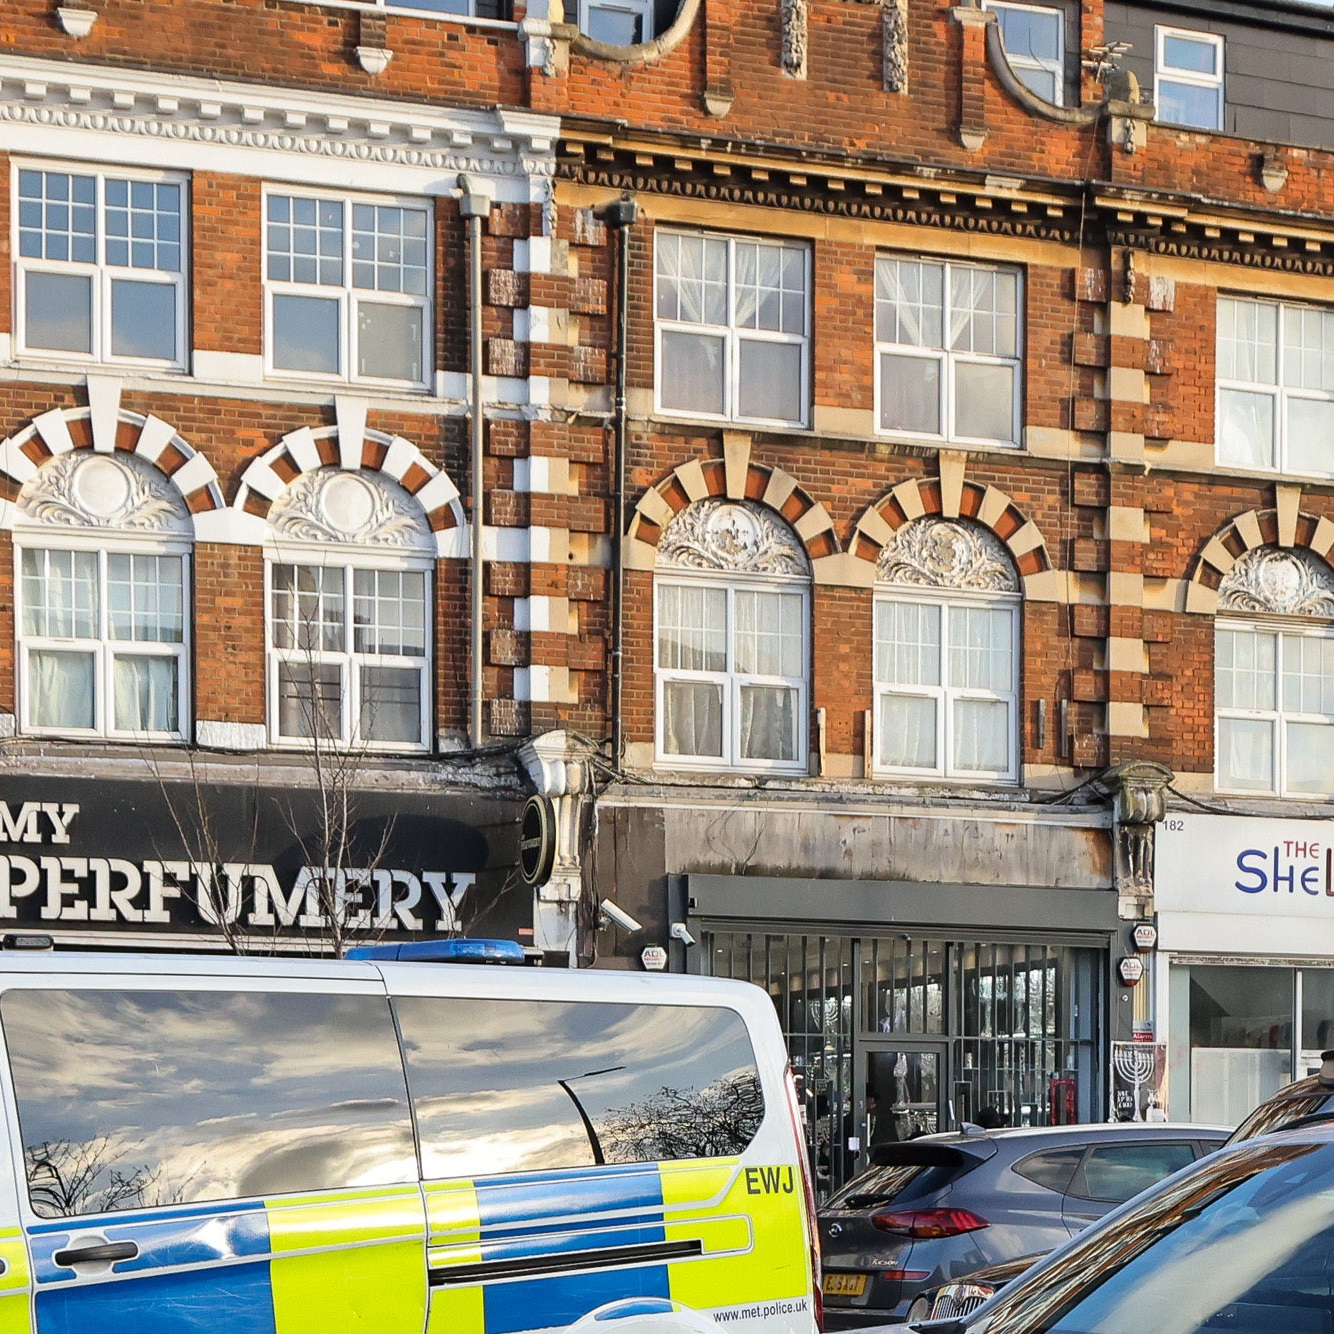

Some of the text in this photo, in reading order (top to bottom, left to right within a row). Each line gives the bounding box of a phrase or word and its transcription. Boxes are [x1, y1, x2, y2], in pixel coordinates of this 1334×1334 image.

[1161, 820, 1184, 832] 182
[1283, 841, 1319, 859] THE
[747, 1167, 793, 1195] EWJ
[713, 1301, 807, 1322] www.met.police.uk
